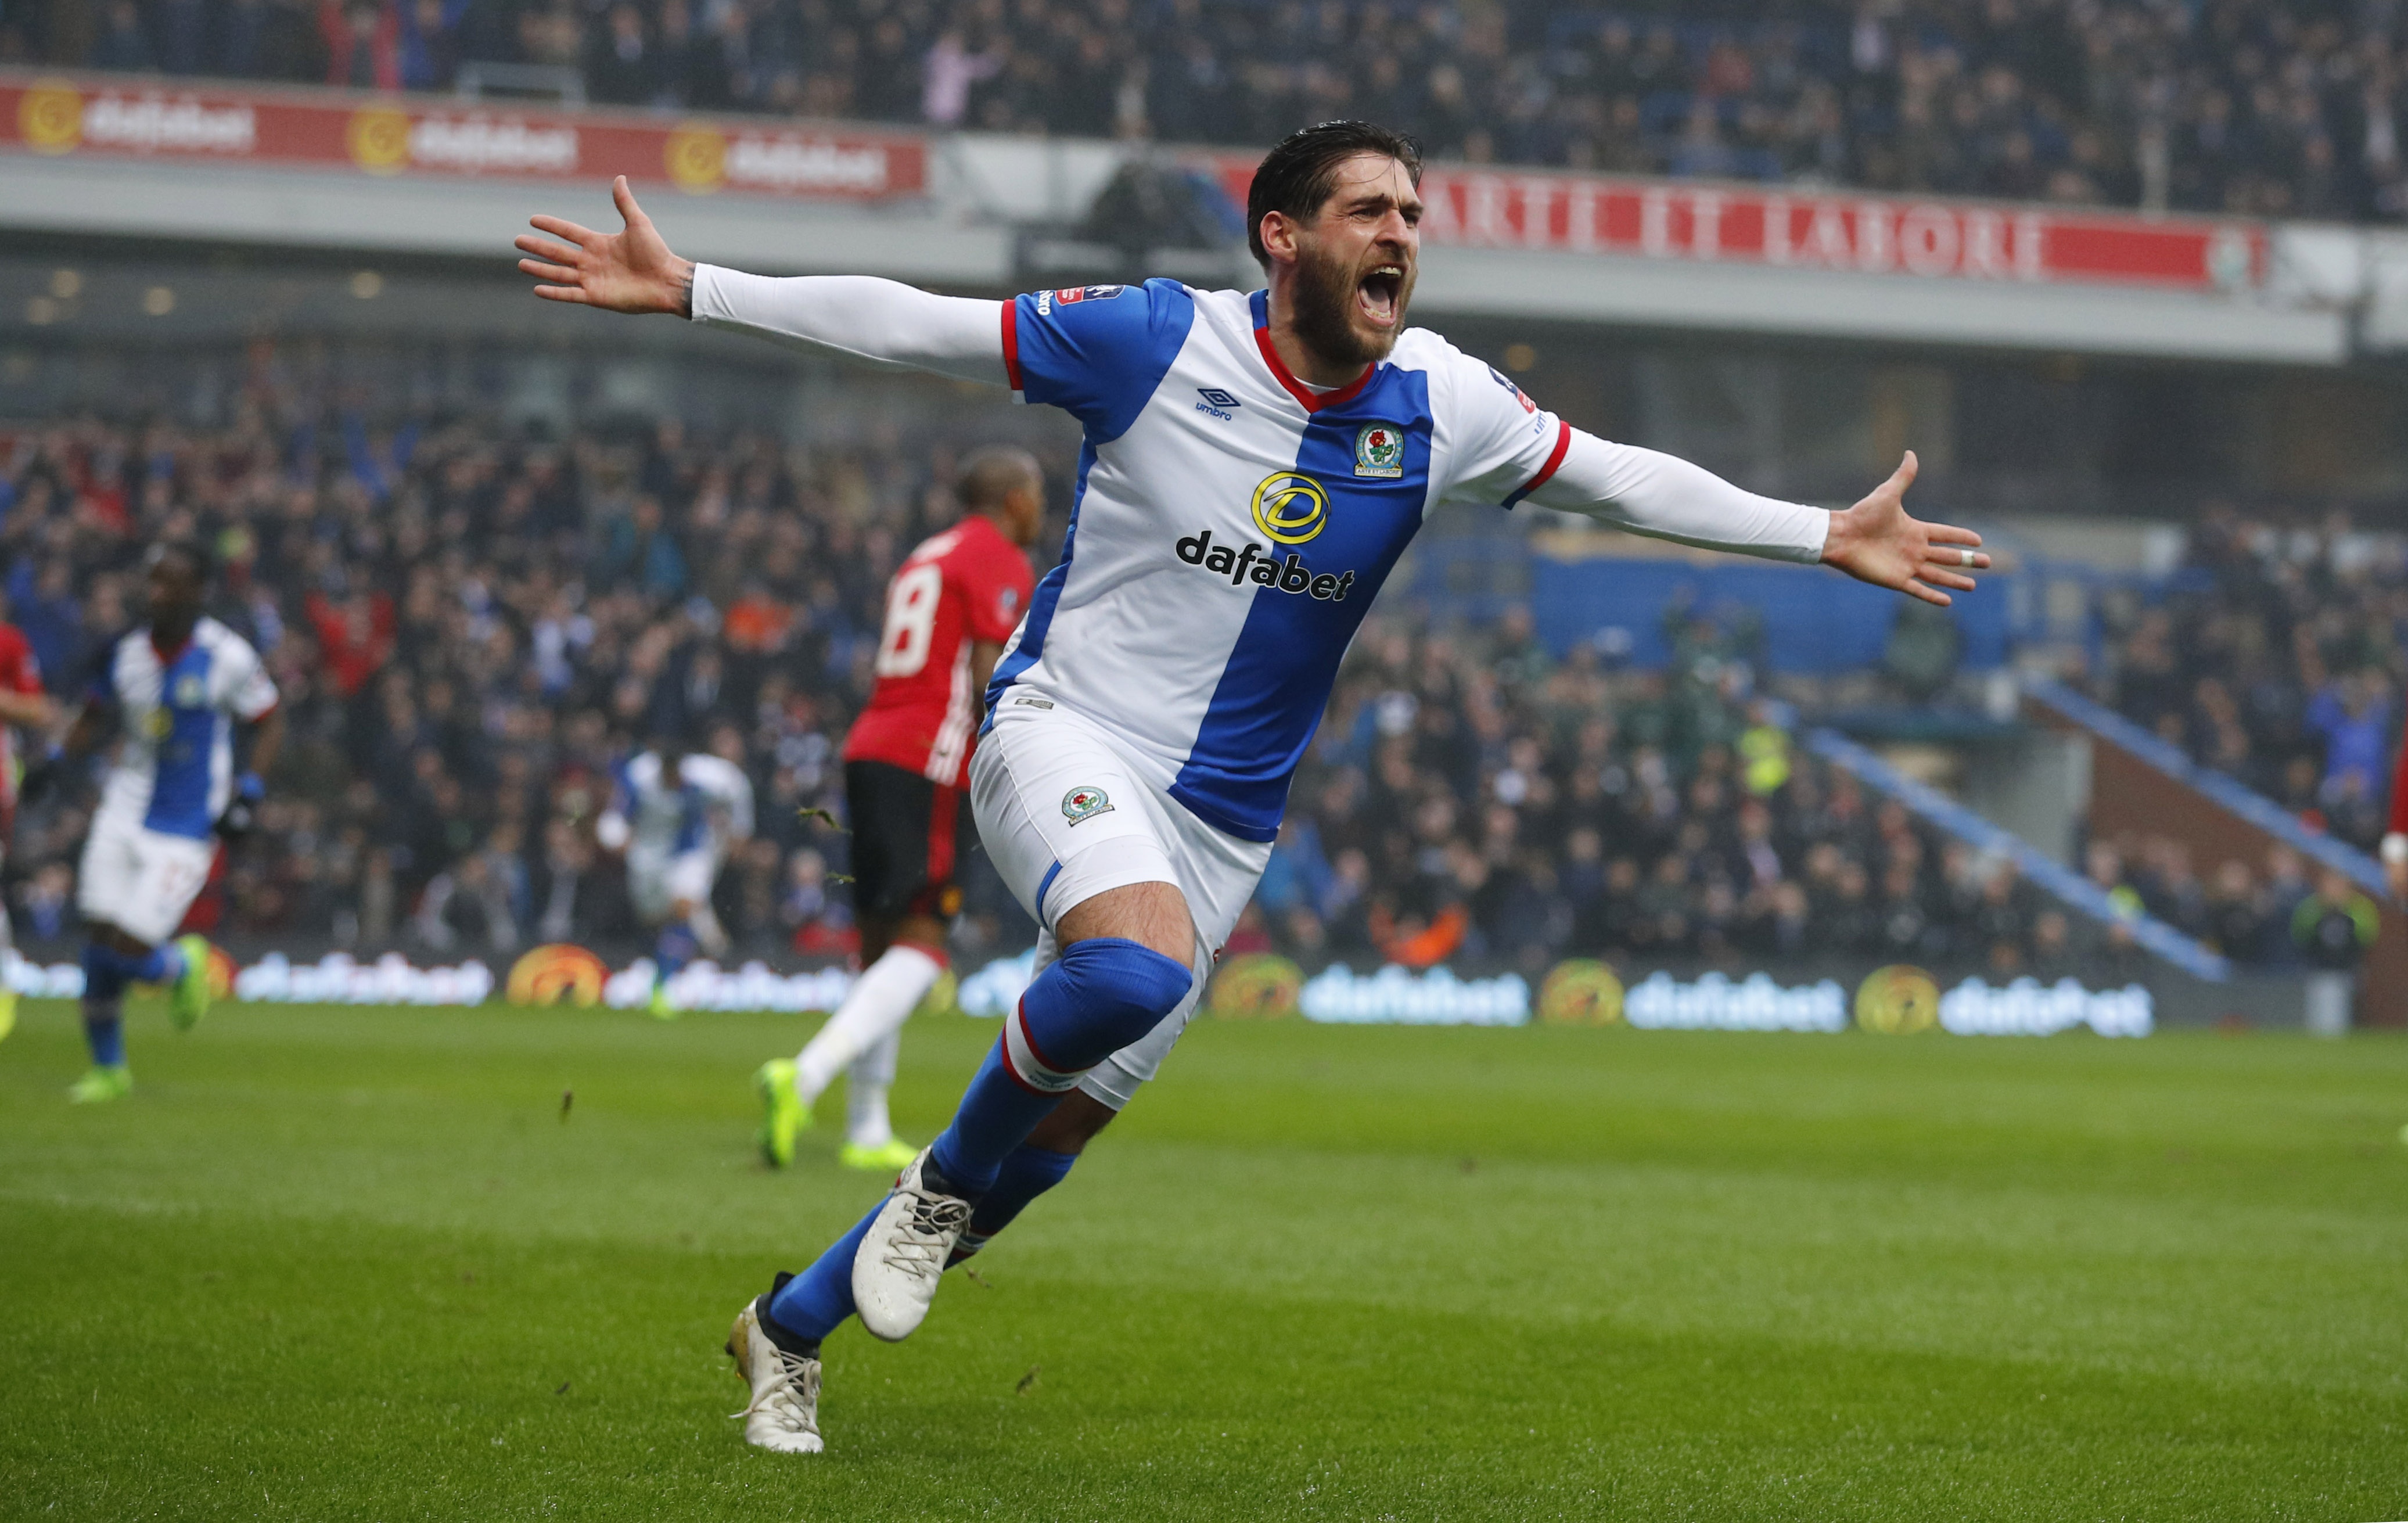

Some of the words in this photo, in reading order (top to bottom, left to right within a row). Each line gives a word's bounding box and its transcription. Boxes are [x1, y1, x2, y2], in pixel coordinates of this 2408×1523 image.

[1639, 185, 1721, 259] ET
[1196, 402, 1232, 421] umbro
[1176, 530, 1354, 602] dafabet
